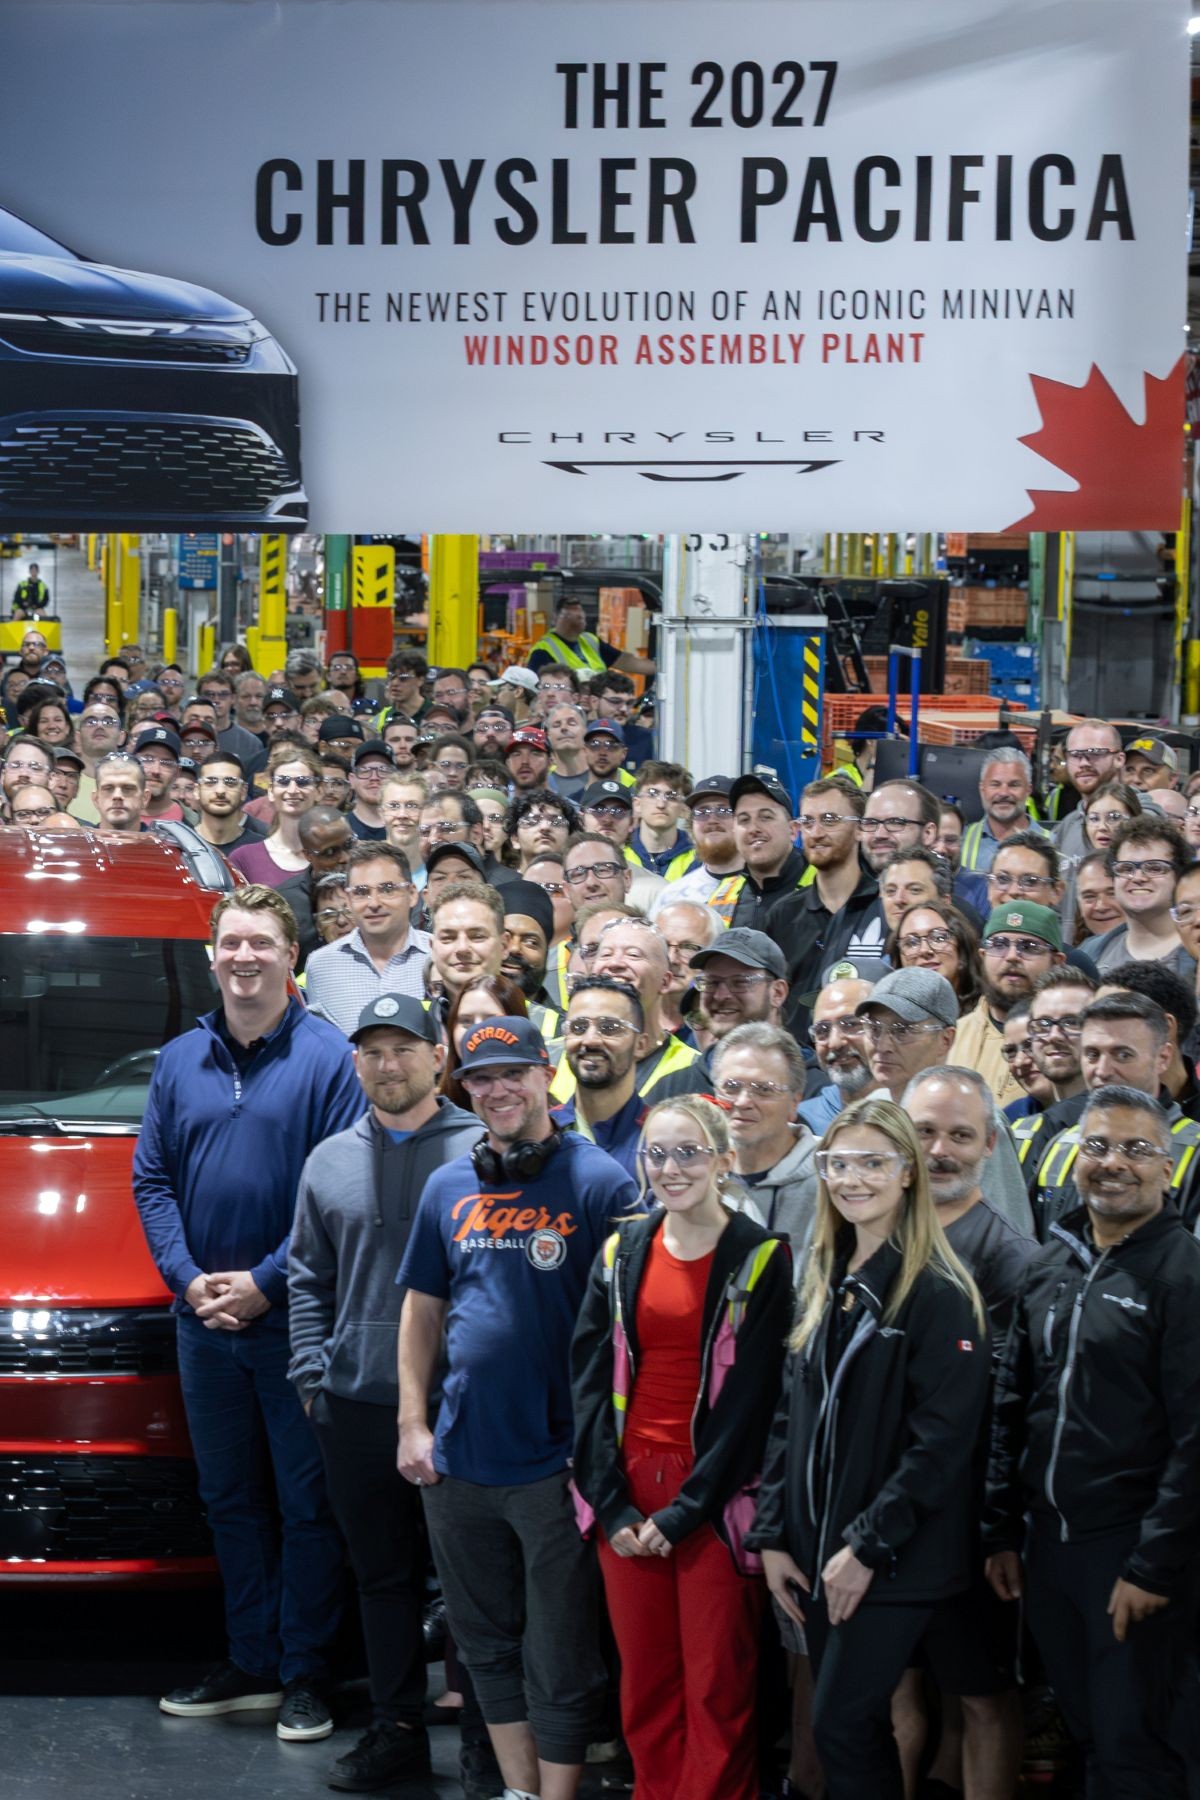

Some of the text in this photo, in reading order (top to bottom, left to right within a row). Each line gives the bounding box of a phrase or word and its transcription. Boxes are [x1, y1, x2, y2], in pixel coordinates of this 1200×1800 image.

[555, 60, 838, 129] THE 2027
[254, 153, 1137, 248] CHRYSLER PACIFICA
[313, 288, 1075, 323] THE NEWEST EVOLUTION OF AN ICONIC MINIVAN
[464, 332, 926, 366] WINDSOR ASSEMBLY PLANT
[497, 430, 886, 445] CHRYSLER
[465, 1026, 520, 1053] DETROIT
[451, 1189, 578, 1242] Tigers
[460, 1238, 526, 1250] BASEBALL
